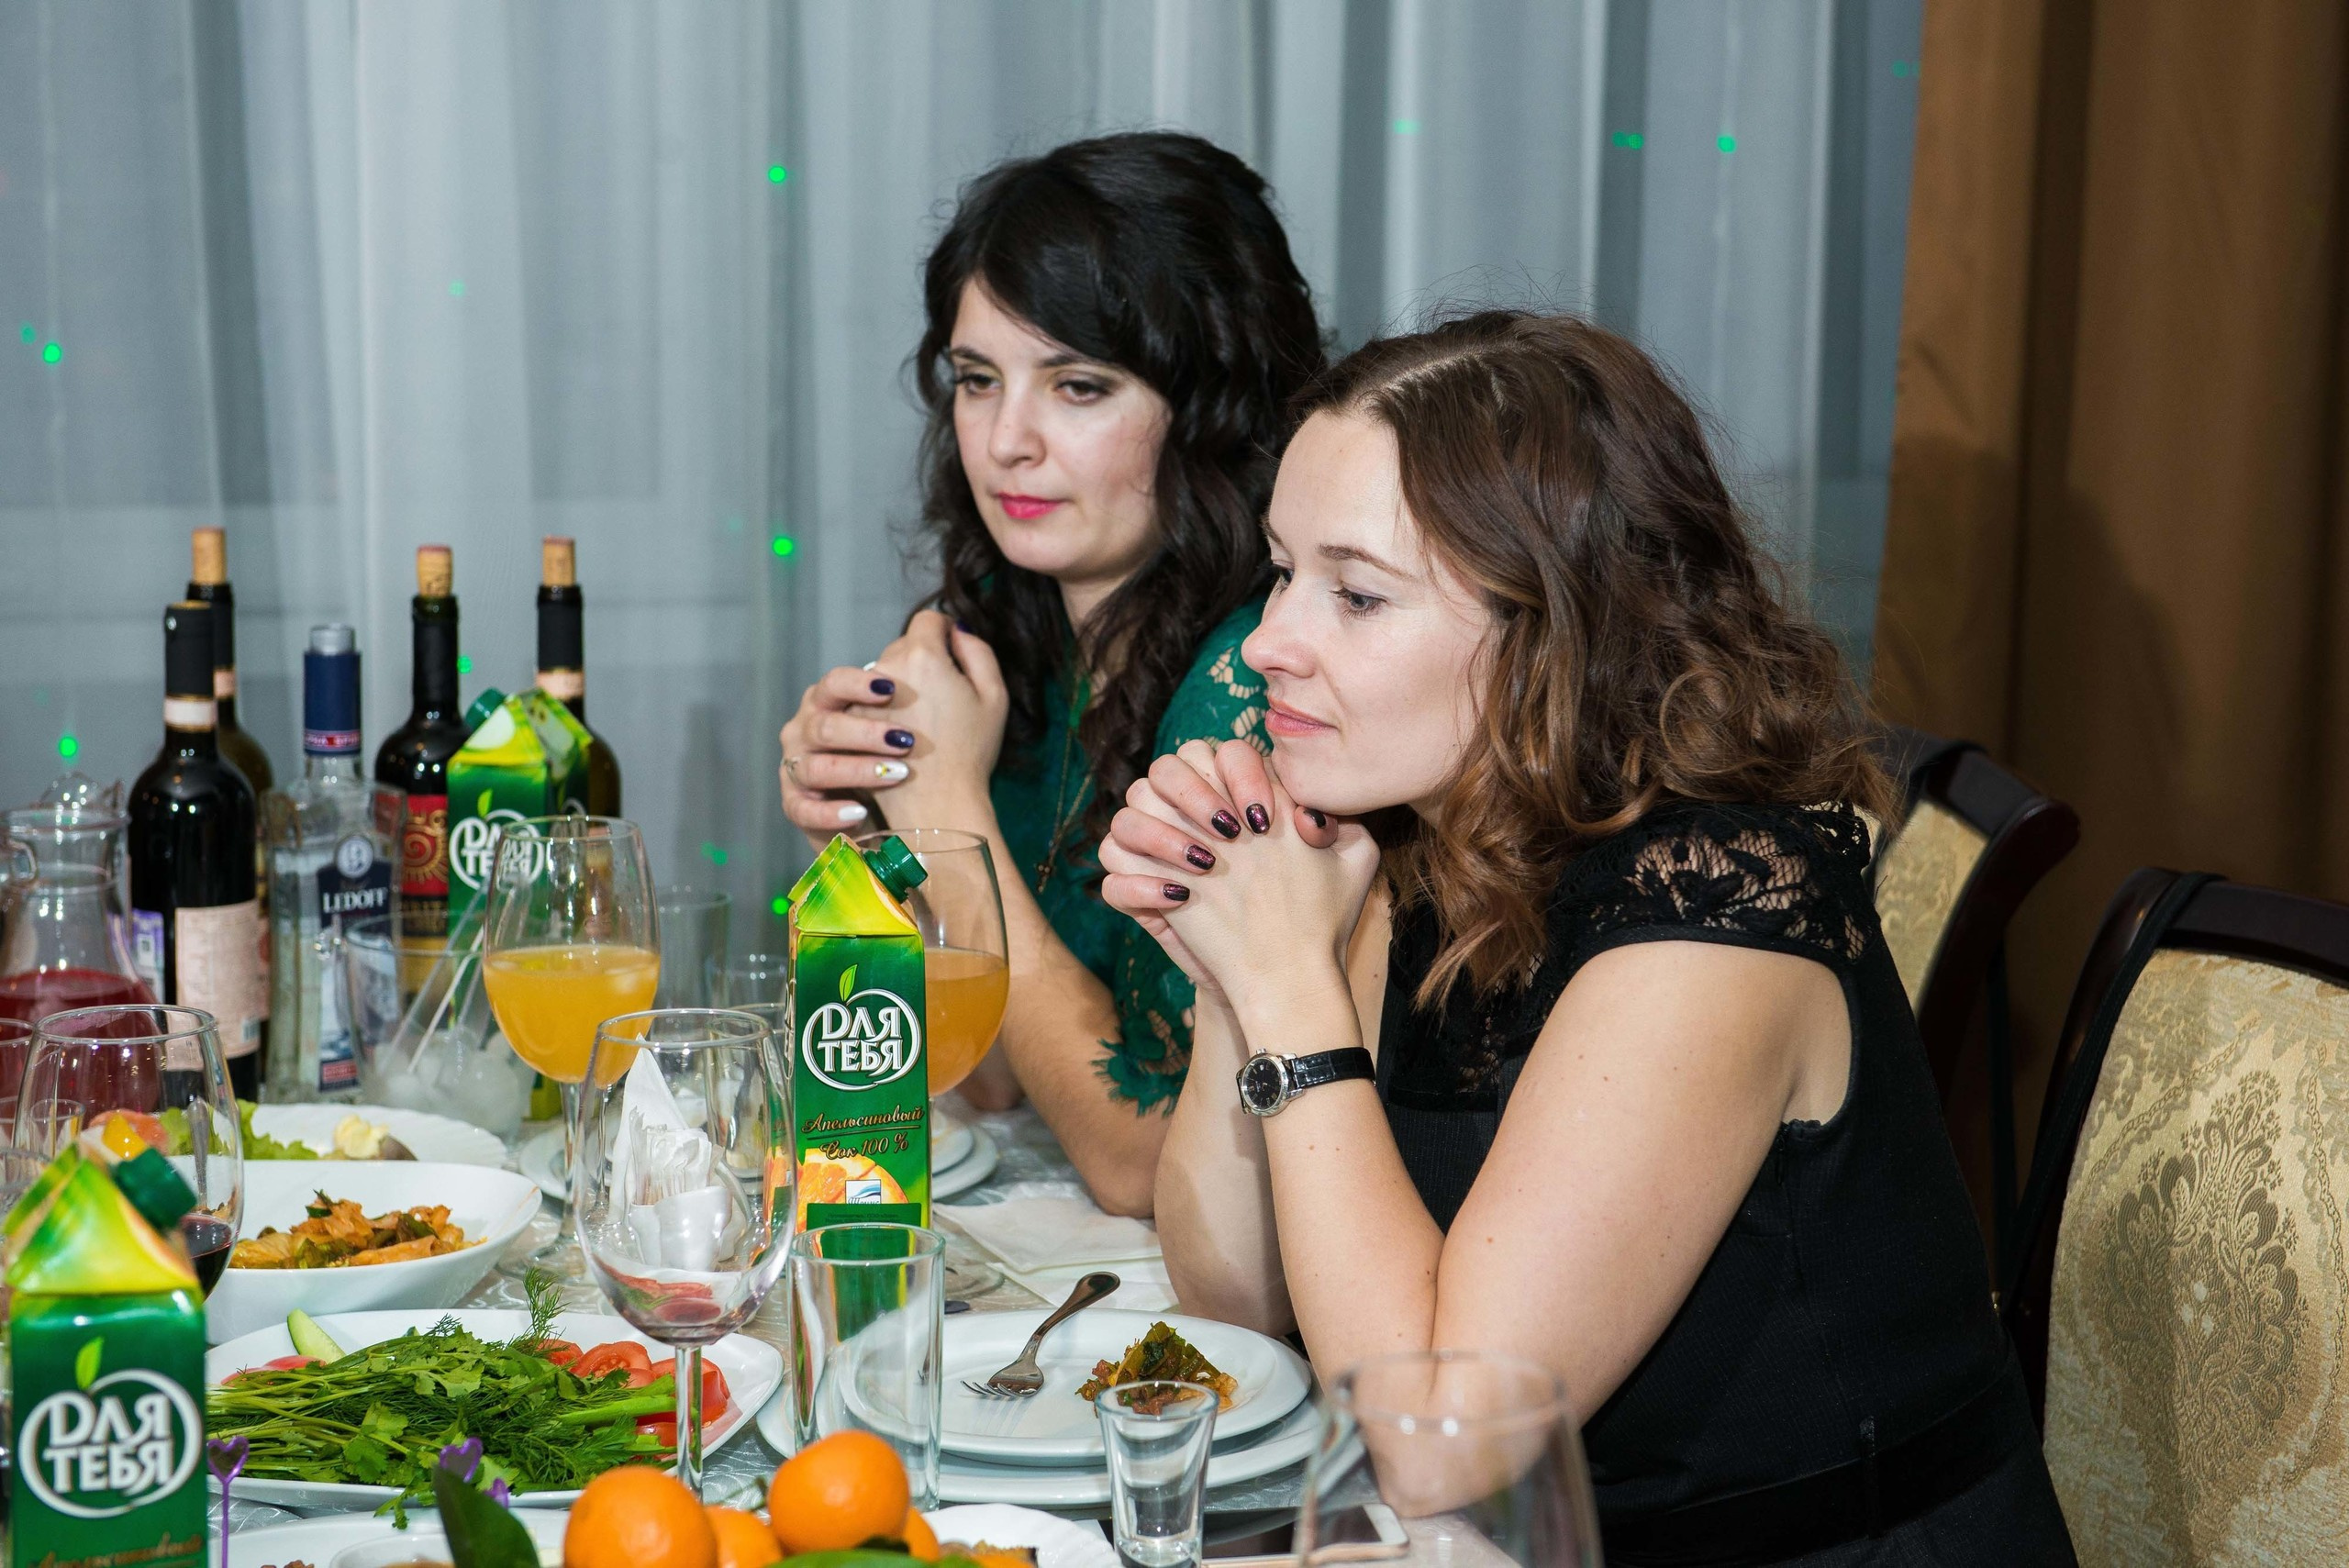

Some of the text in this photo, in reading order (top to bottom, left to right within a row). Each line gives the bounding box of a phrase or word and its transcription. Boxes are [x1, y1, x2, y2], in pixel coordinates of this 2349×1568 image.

[817, 1038, 904, 1077] ТЕБЯ
[801, 1104, 925, 1133] Апельсиновый
[819, 1140, 858, 1160] Сок
[861, 1137, 889, 1157] 100
[42, 1438, 174, 1497] ТЕБЯ
